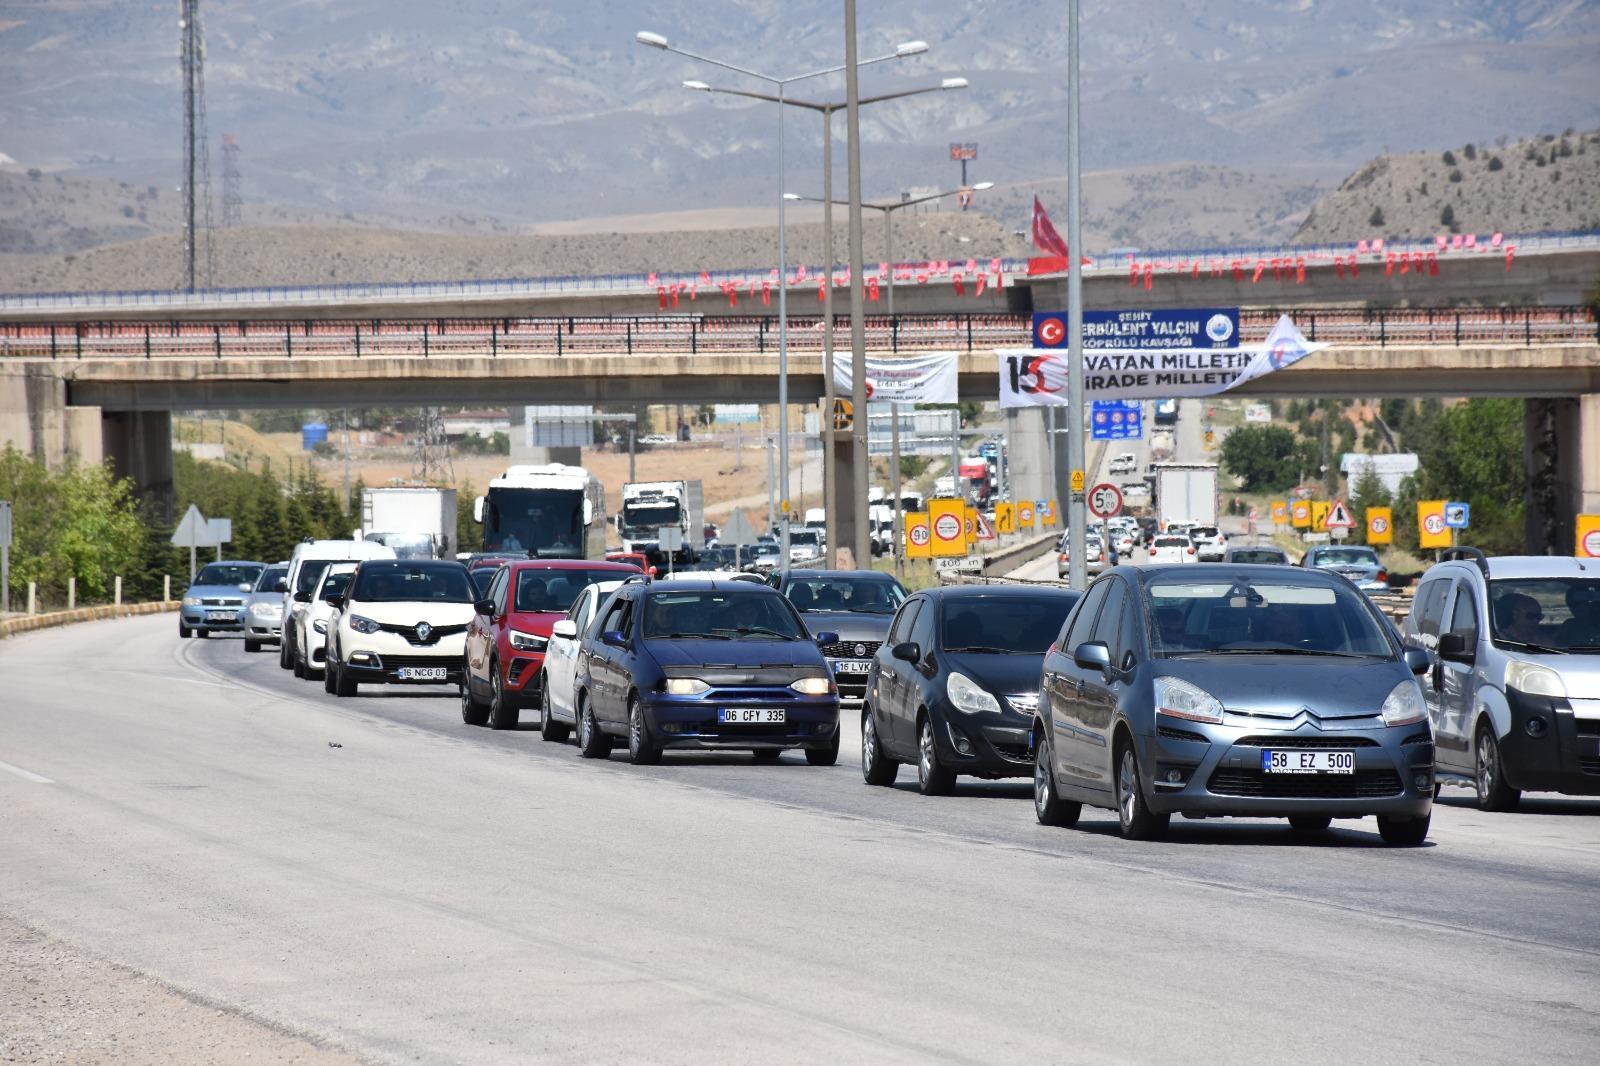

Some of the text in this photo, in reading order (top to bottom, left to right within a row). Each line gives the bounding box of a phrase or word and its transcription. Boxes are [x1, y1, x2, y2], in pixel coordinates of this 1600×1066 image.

[1118, 311, 1152, 323] ŞEHİT
[1082, 320, 1199, 337] ERBÜLENT YALÇIN
[1085, 355, 1154, 371] VATAN
[1095, 492, 1104, 508] 5
[914, 529, 928, 541] 90
[403, 669, 412, 677] 16
[435, 669, 446, 677] 03
[725, 710, 784, 721] 06 CFY 335
[1272, 752, 1352, 768] 58 EZ 500
